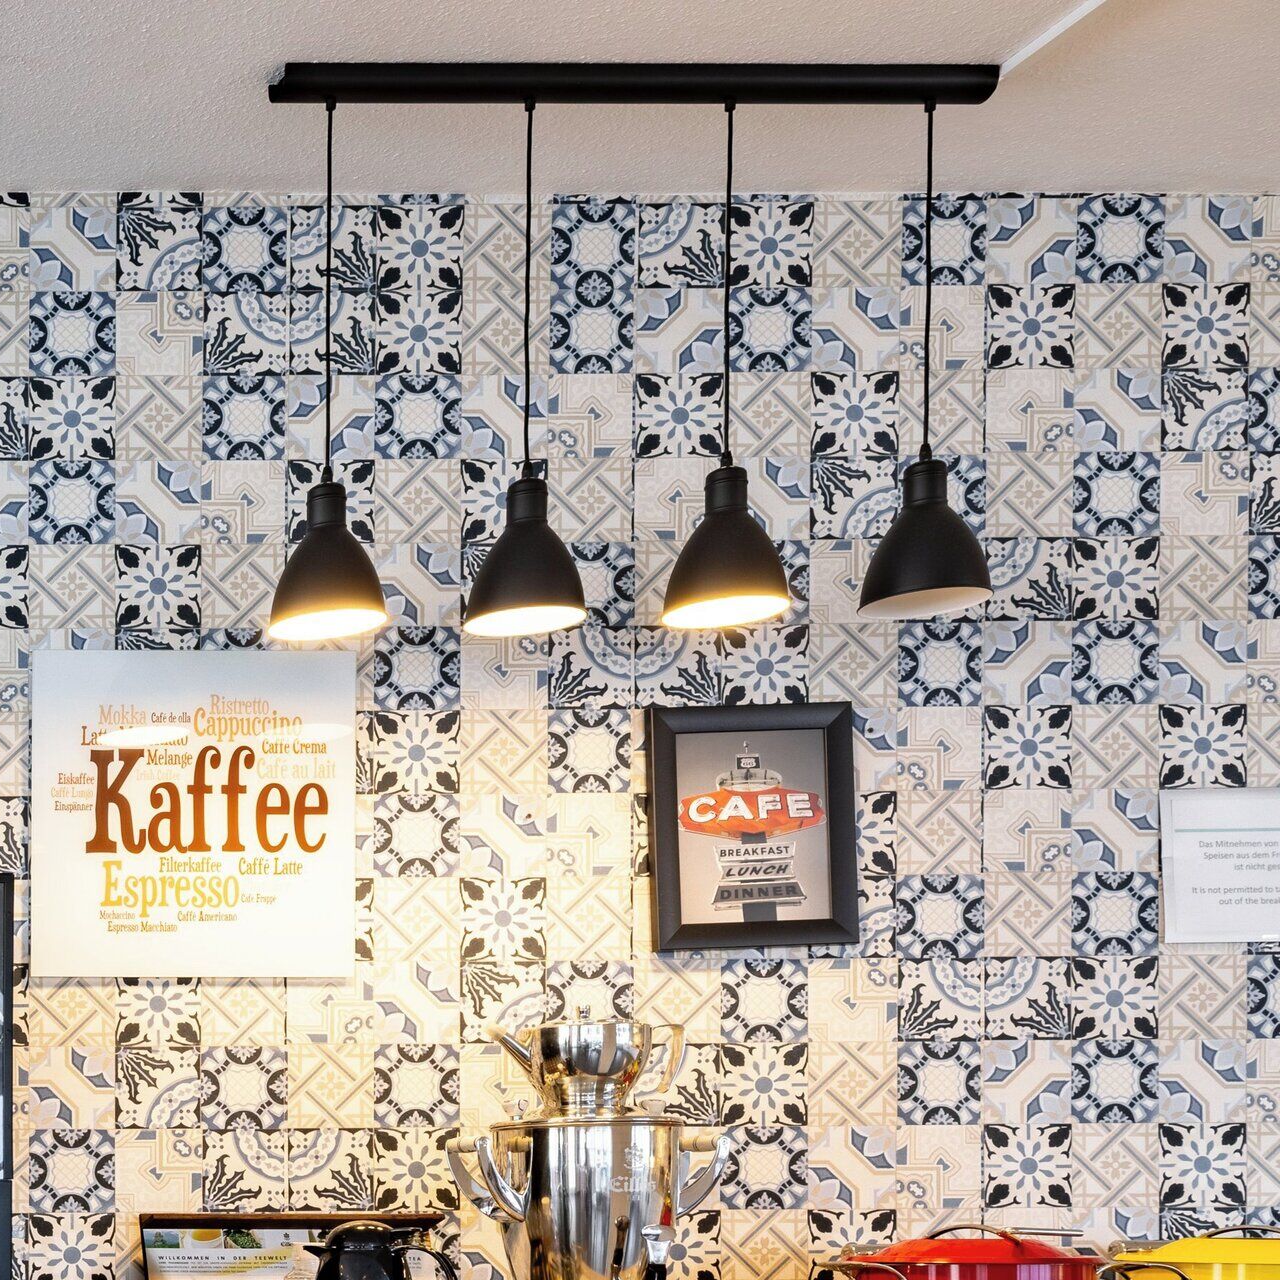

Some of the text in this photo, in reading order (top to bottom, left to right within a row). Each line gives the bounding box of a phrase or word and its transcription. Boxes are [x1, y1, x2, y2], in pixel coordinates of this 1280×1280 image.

[209, 694, 270, 714] Ristretto
[98, 704, 147, 725] Mokka
[151, 711, 191, 724] Café de olla
[193, 707, 303, 742] Cappuccino
[292, 738, 327, 755] Crema
[146, 750, 193, 768] Melange
[256, 757, 336, 779] Café au lait
[57, 773, 95, 785] Eiskaffee
[71, 787, 95, 800] Lungo
[85, 745, 329, 854] Kaffee
[54, 801, 94, 813] Einspänner
[688, 793, 814, 823] CAFE
[1215, 840, 1262, 848] Mitnehmen
[719, 846, 791, 858] BREAKFAST
[1203, 852, 1235, 861] Speisen
[1252, 851, 1270, 859] dem
[159, 857, 222, 873] Filterkaffee
[273, 857, 304, 876] Latte
[726, 863, 789, 877] LUNCH
[1234, 863, 1244, 871] ist
[1246, 863, 1266, 871] nicht
[100, 860, 240, 919] Espresso
[720, 885, 798, 900] DINNER
[1192, 886, 1198, 894] It
[1200, 886, 1206, 894] is
[1223, 886, 1263, 895] permitted
[1234, 897, 1243, 905] of
[1245, 897, 1259, 905] the
[100, 910, 136, 920] Mochaccino
[198, 910, 238, 922] Americano
[107, 921, 178, 935] Espresso Macchiato
